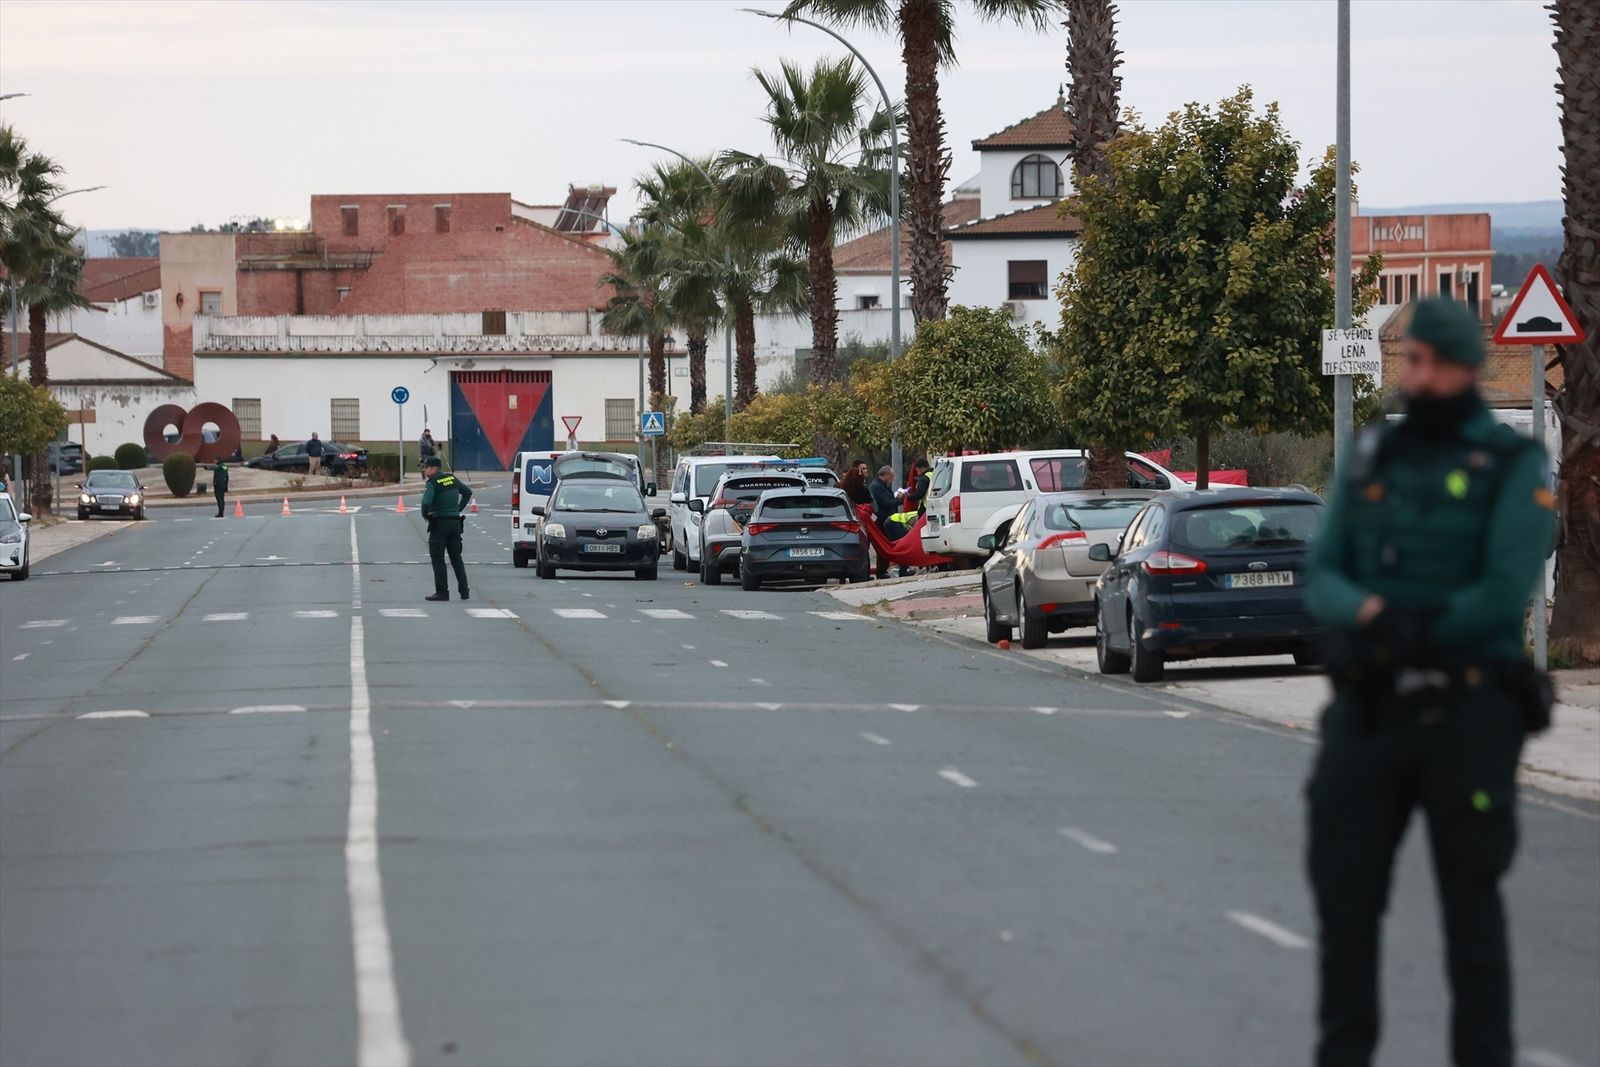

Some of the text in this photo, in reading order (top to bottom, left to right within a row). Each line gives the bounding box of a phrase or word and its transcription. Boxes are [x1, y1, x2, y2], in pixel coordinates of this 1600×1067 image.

[1343, 329, 1373, 341] VENDE
[1341, 343, 1366, 358] LEÑA
[791, 548, 808, 556] 3856
[1233, 572, 1290, 586] 7388 HTM
